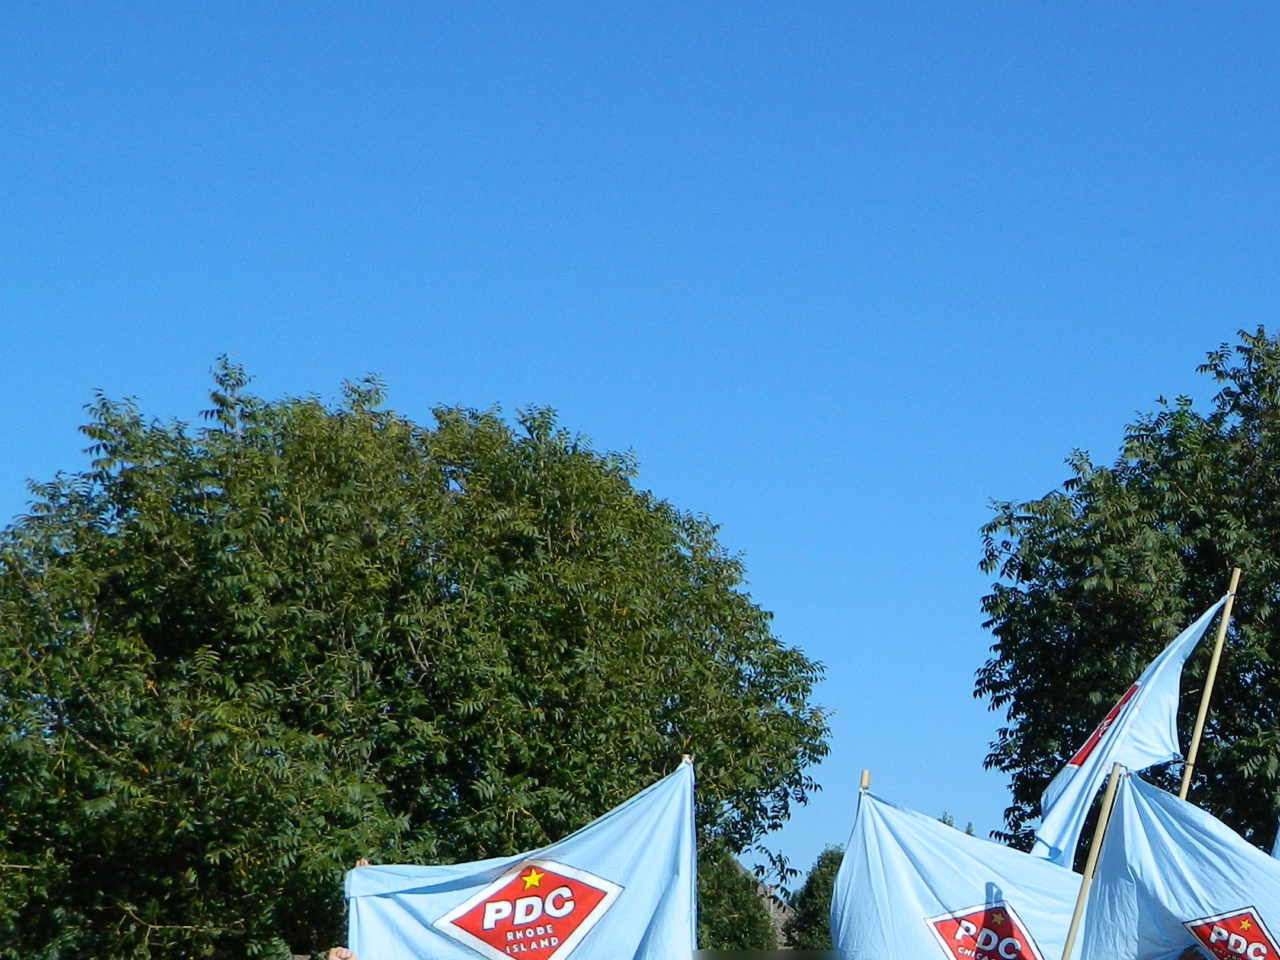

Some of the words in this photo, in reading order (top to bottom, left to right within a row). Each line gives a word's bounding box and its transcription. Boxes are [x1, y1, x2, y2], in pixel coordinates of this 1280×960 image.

[481, 884, 576, 931] PDC
[505, 937, 560, 954] ISLAND
[506, 924, 554, 942] RHODE
[954, 919, 1021, 960] PDC
